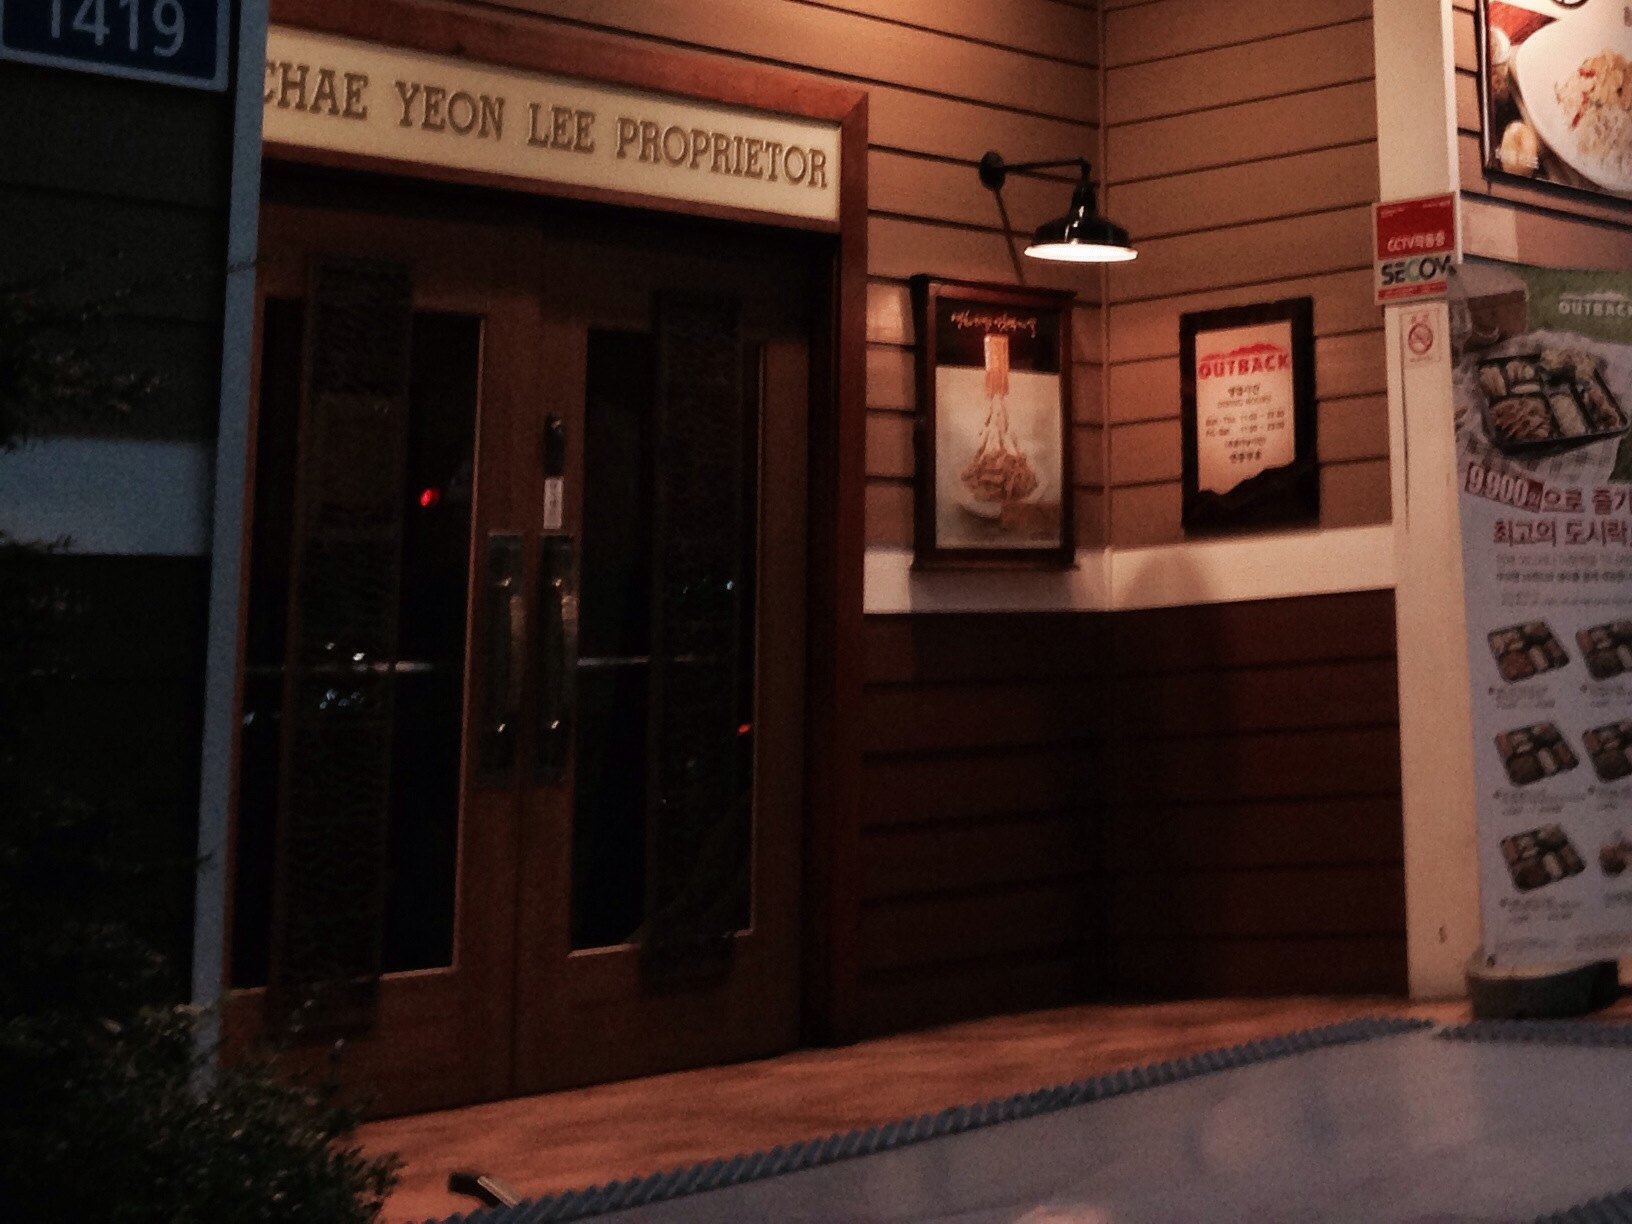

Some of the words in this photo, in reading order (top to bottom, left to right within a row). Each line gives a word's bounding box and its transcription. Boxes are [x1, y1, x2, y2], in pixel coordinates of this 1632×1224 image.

[395, 80, 505, 141] YEON
[527, 102, 596, 153] LEE
[616, 116, 828, 189] PROPRIETOR
[1198, 355, 1290, 380] OUTBACK
[1493, 519, 1556, 547] 최고의
